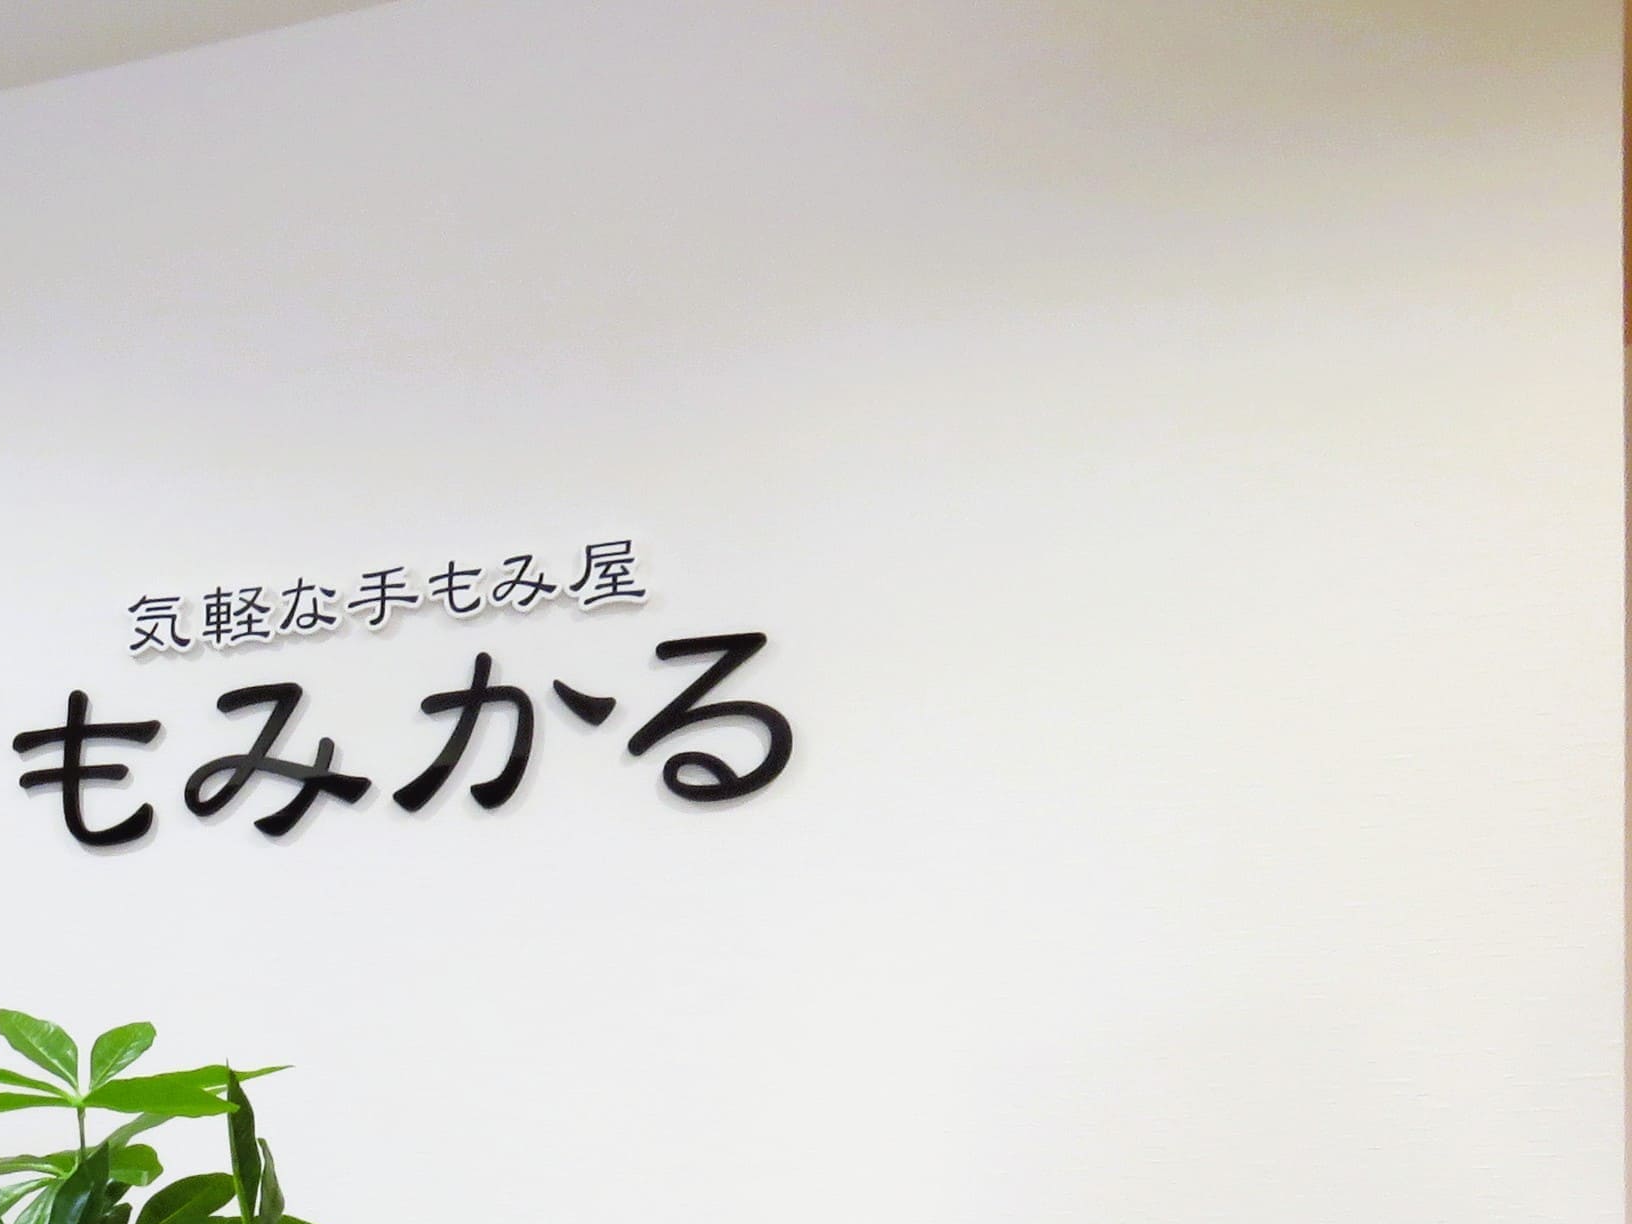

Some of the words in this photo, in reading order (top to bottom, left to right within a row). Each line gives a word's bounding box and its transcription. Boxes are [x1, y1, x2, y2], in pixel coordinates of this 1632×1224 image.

[128, 540, 646, 651] 気軽な手もみ屋
[13, 633, 792, 847] もみかる
